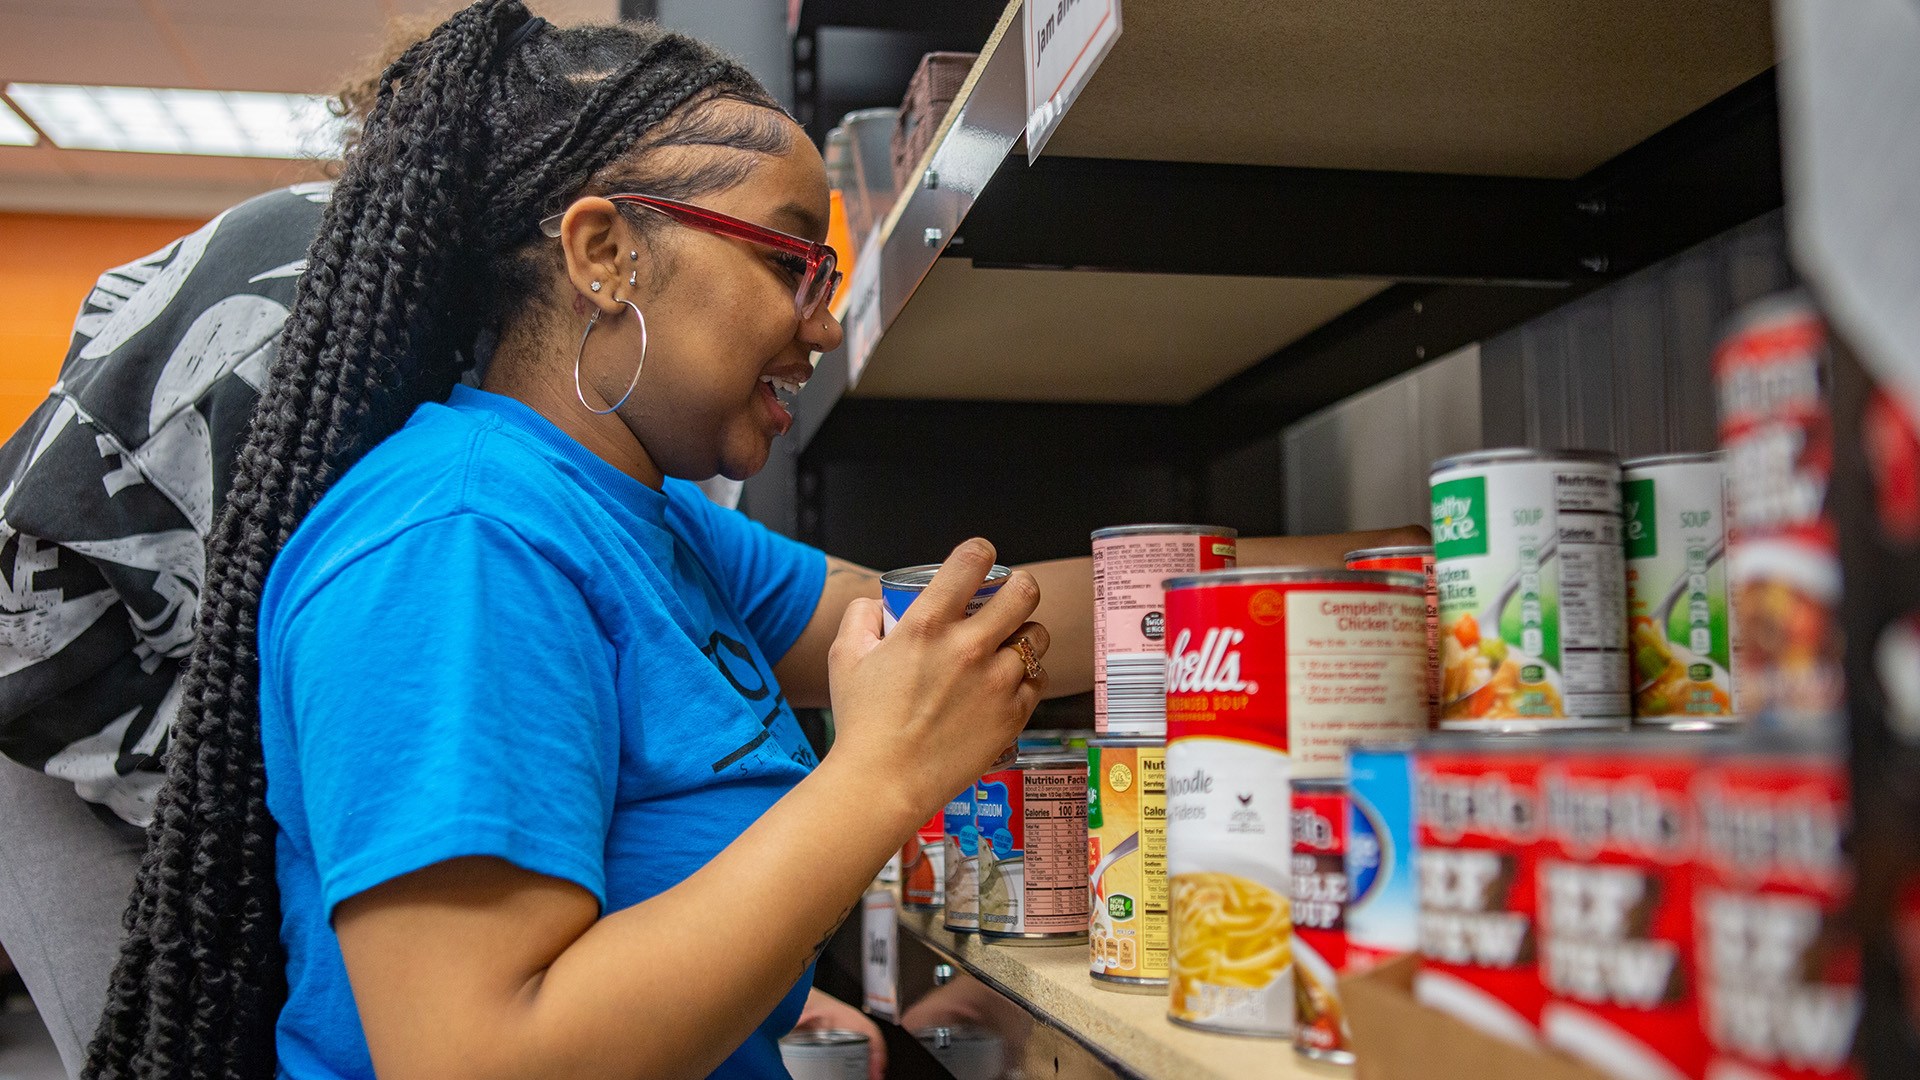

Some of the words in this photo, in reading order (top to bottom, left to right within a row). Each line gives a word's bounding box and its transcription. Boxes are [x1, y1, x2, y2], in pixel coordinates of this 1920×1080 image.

[1037, 13, 1055, 68] Jam
[1513, 508, 1543, 526] SOUP
[1681, 510, 1711, 528] SOUP
[1448, 585, 1476, 600] Rice
[1320, 600, 1394, 617] Campbell's
[1338, 617, 1389, 632] Chicken
[1213, 695, 1248, 711] SOUP
[1144, 760, 1166, 770] Nut
[1024, 776, 1066, 785] Nutrition
[1067, 775, 1087, 785] Facts
[1025, 808, 1050, 817] Calories
[1058, 805, 1072, 816] 100
[1110, 904, 1126, 912] BPA
